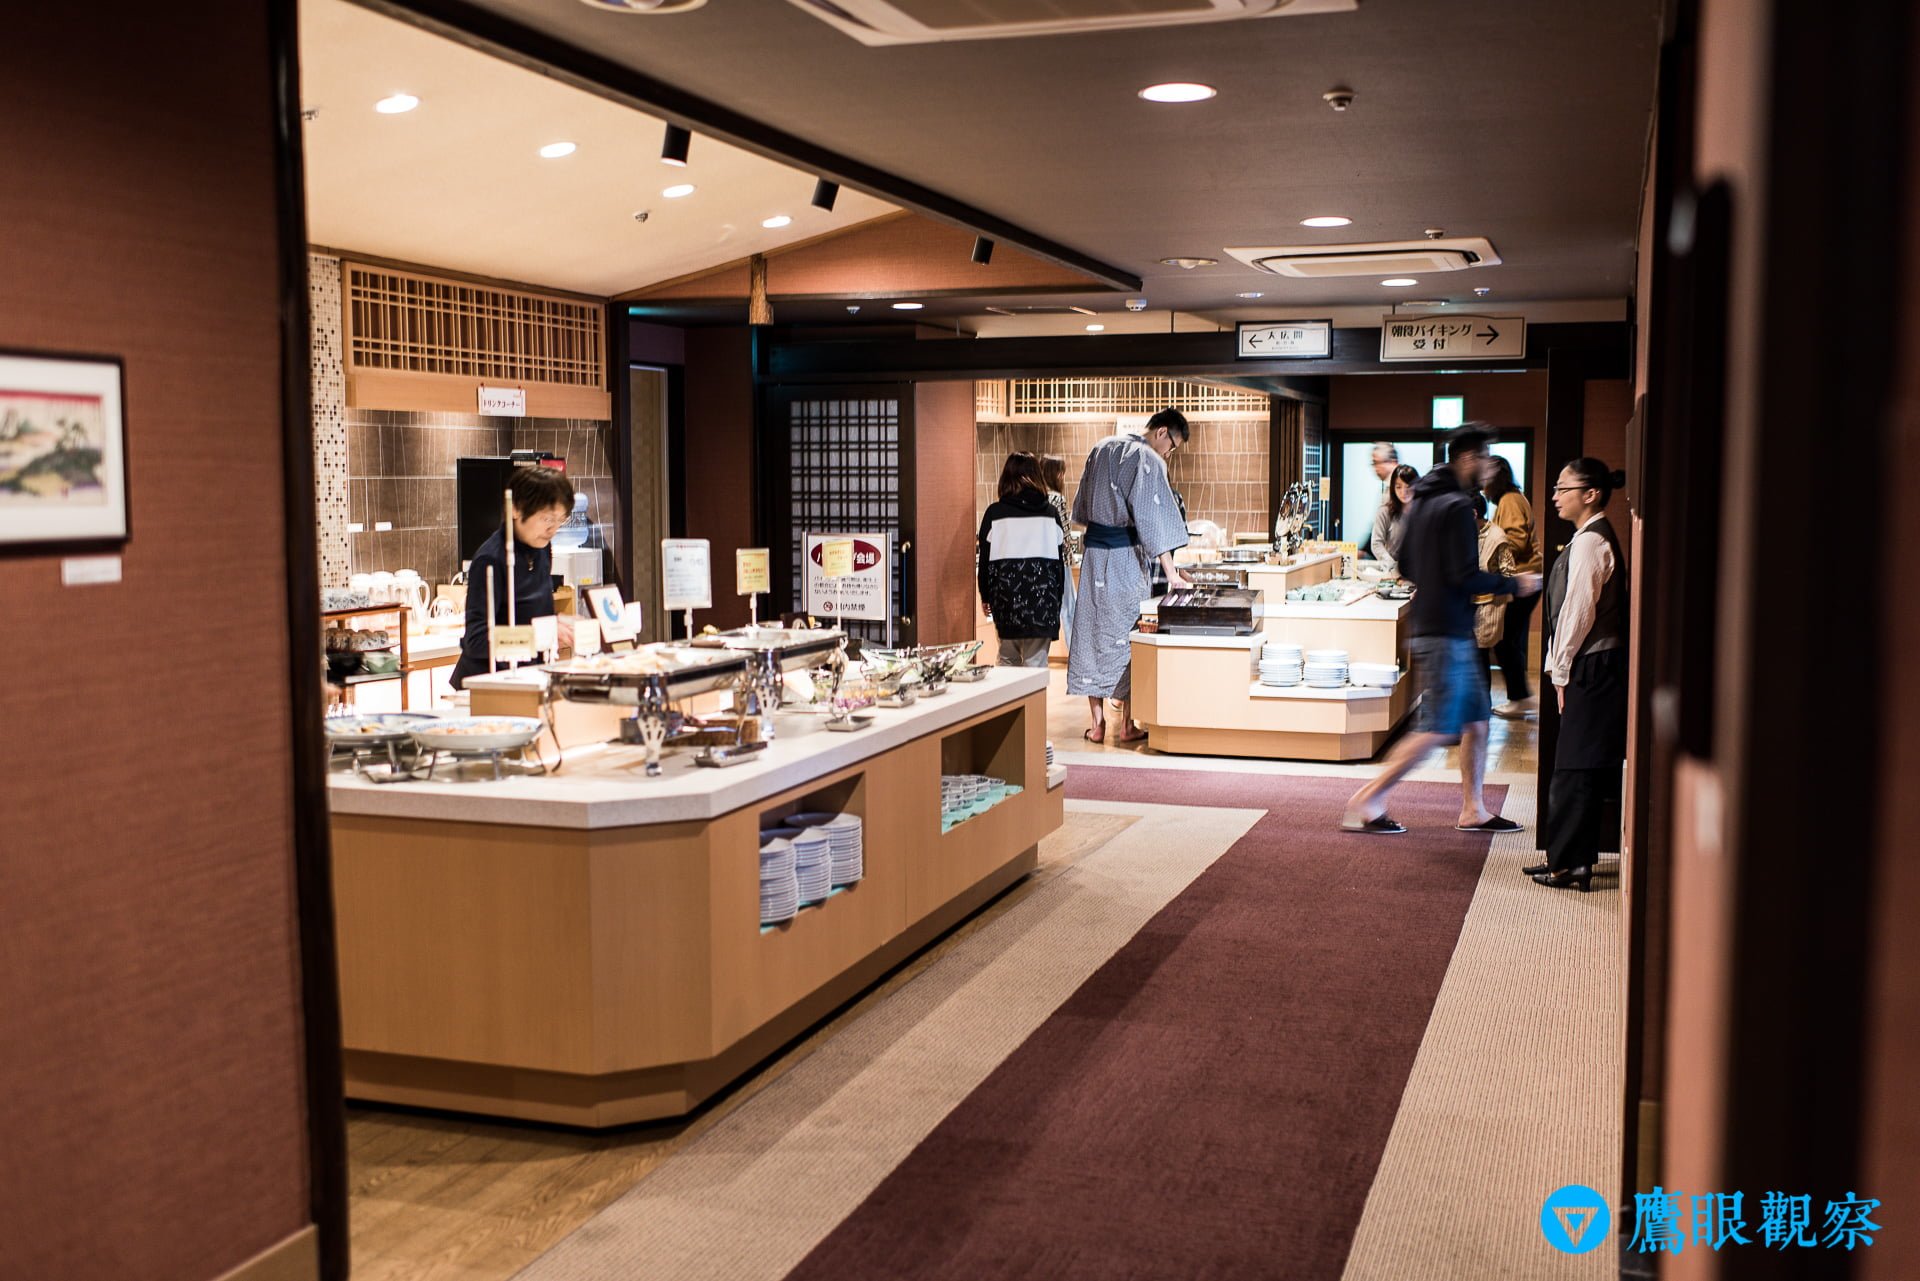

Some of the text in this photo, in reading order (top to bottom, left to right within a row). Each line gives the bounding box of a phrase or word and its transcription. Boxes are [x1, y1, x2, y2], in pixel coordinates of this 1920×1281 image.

[1391, 324, 1472, 338] 朝食バイキング
[1413, 338, 1445, 350] 受付
